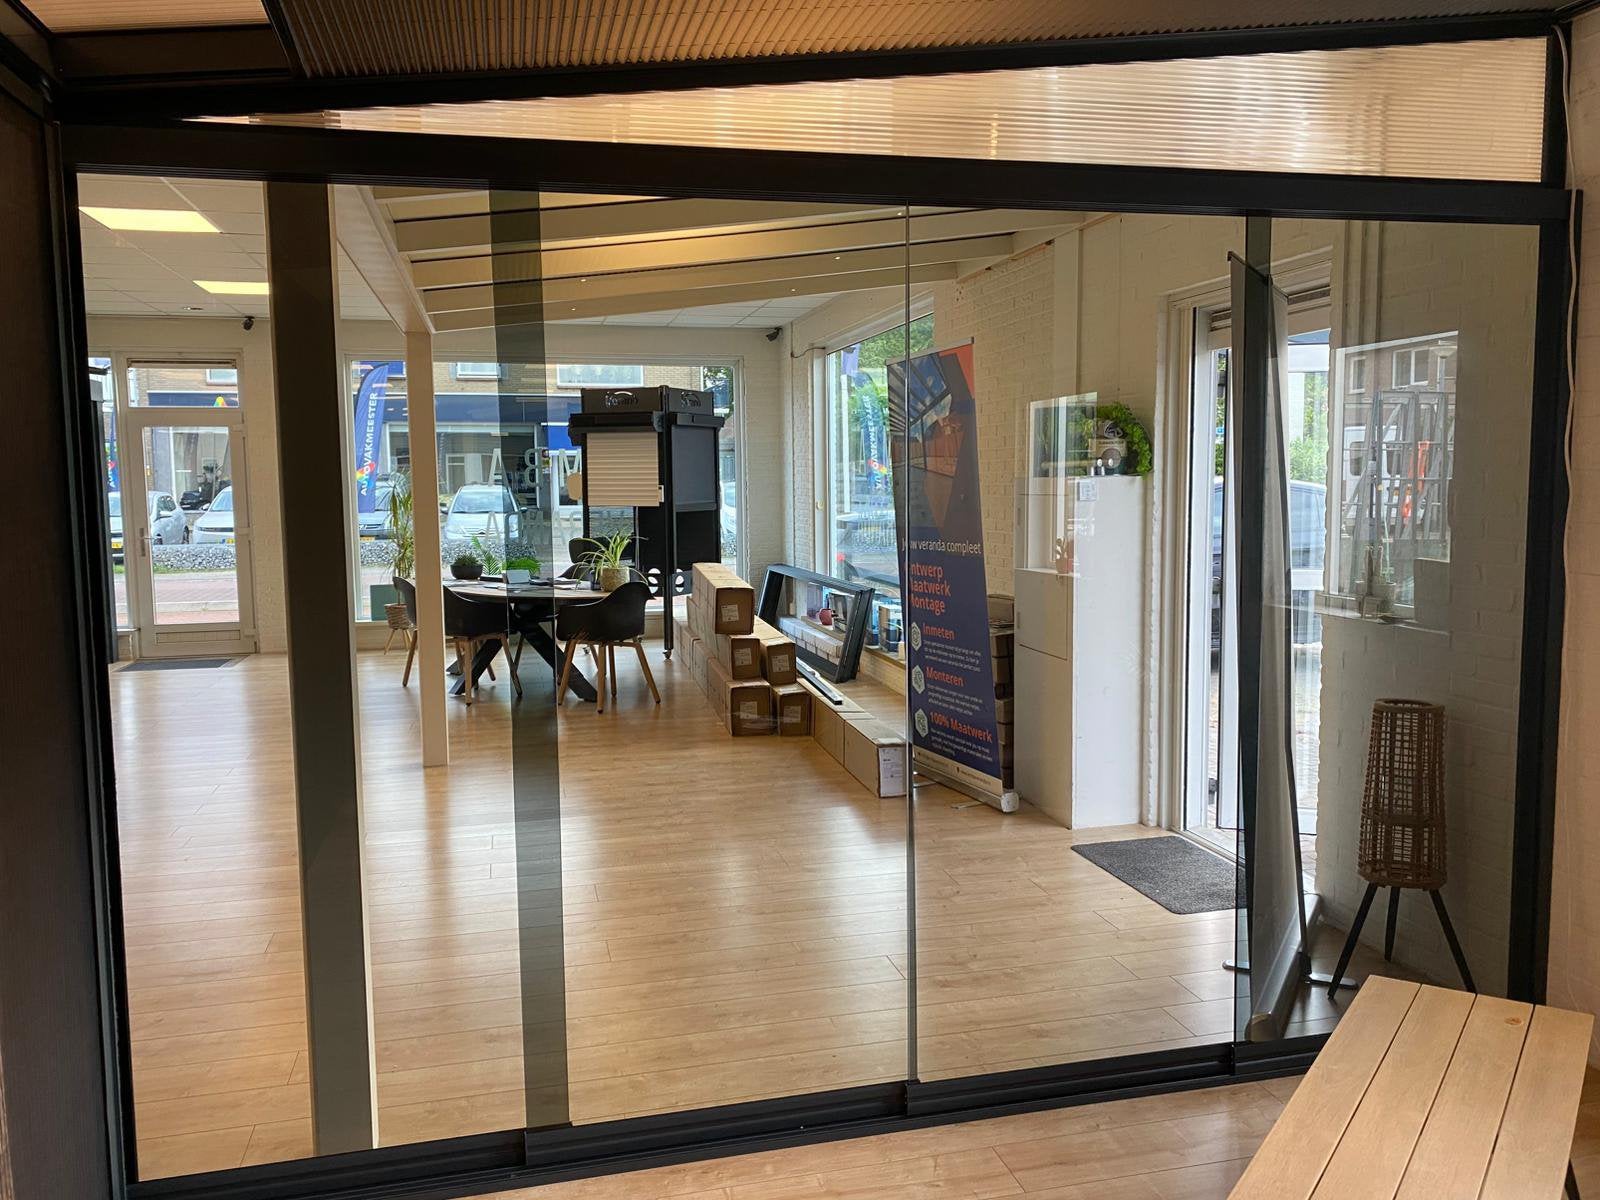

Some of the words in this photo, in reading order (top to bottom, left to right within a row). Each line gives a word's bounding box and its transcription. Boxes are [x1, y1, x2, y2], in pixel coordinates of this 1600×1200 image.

[360, 392, 378, 496] AUTOVAKMEESTER
[918, 540, 945, 551] veranda
[946, 541, 982, 556] compleet
[904, 562, 944, 581] ntwerp
[909, 578, 952, 597] aatwerk
[922, 622, 955, 640] Inmeten
[925, 666, 965, 687] Monteren
[929, 711, 950, 729] 100%
[950, 719, 993, 744] Maatwerk
